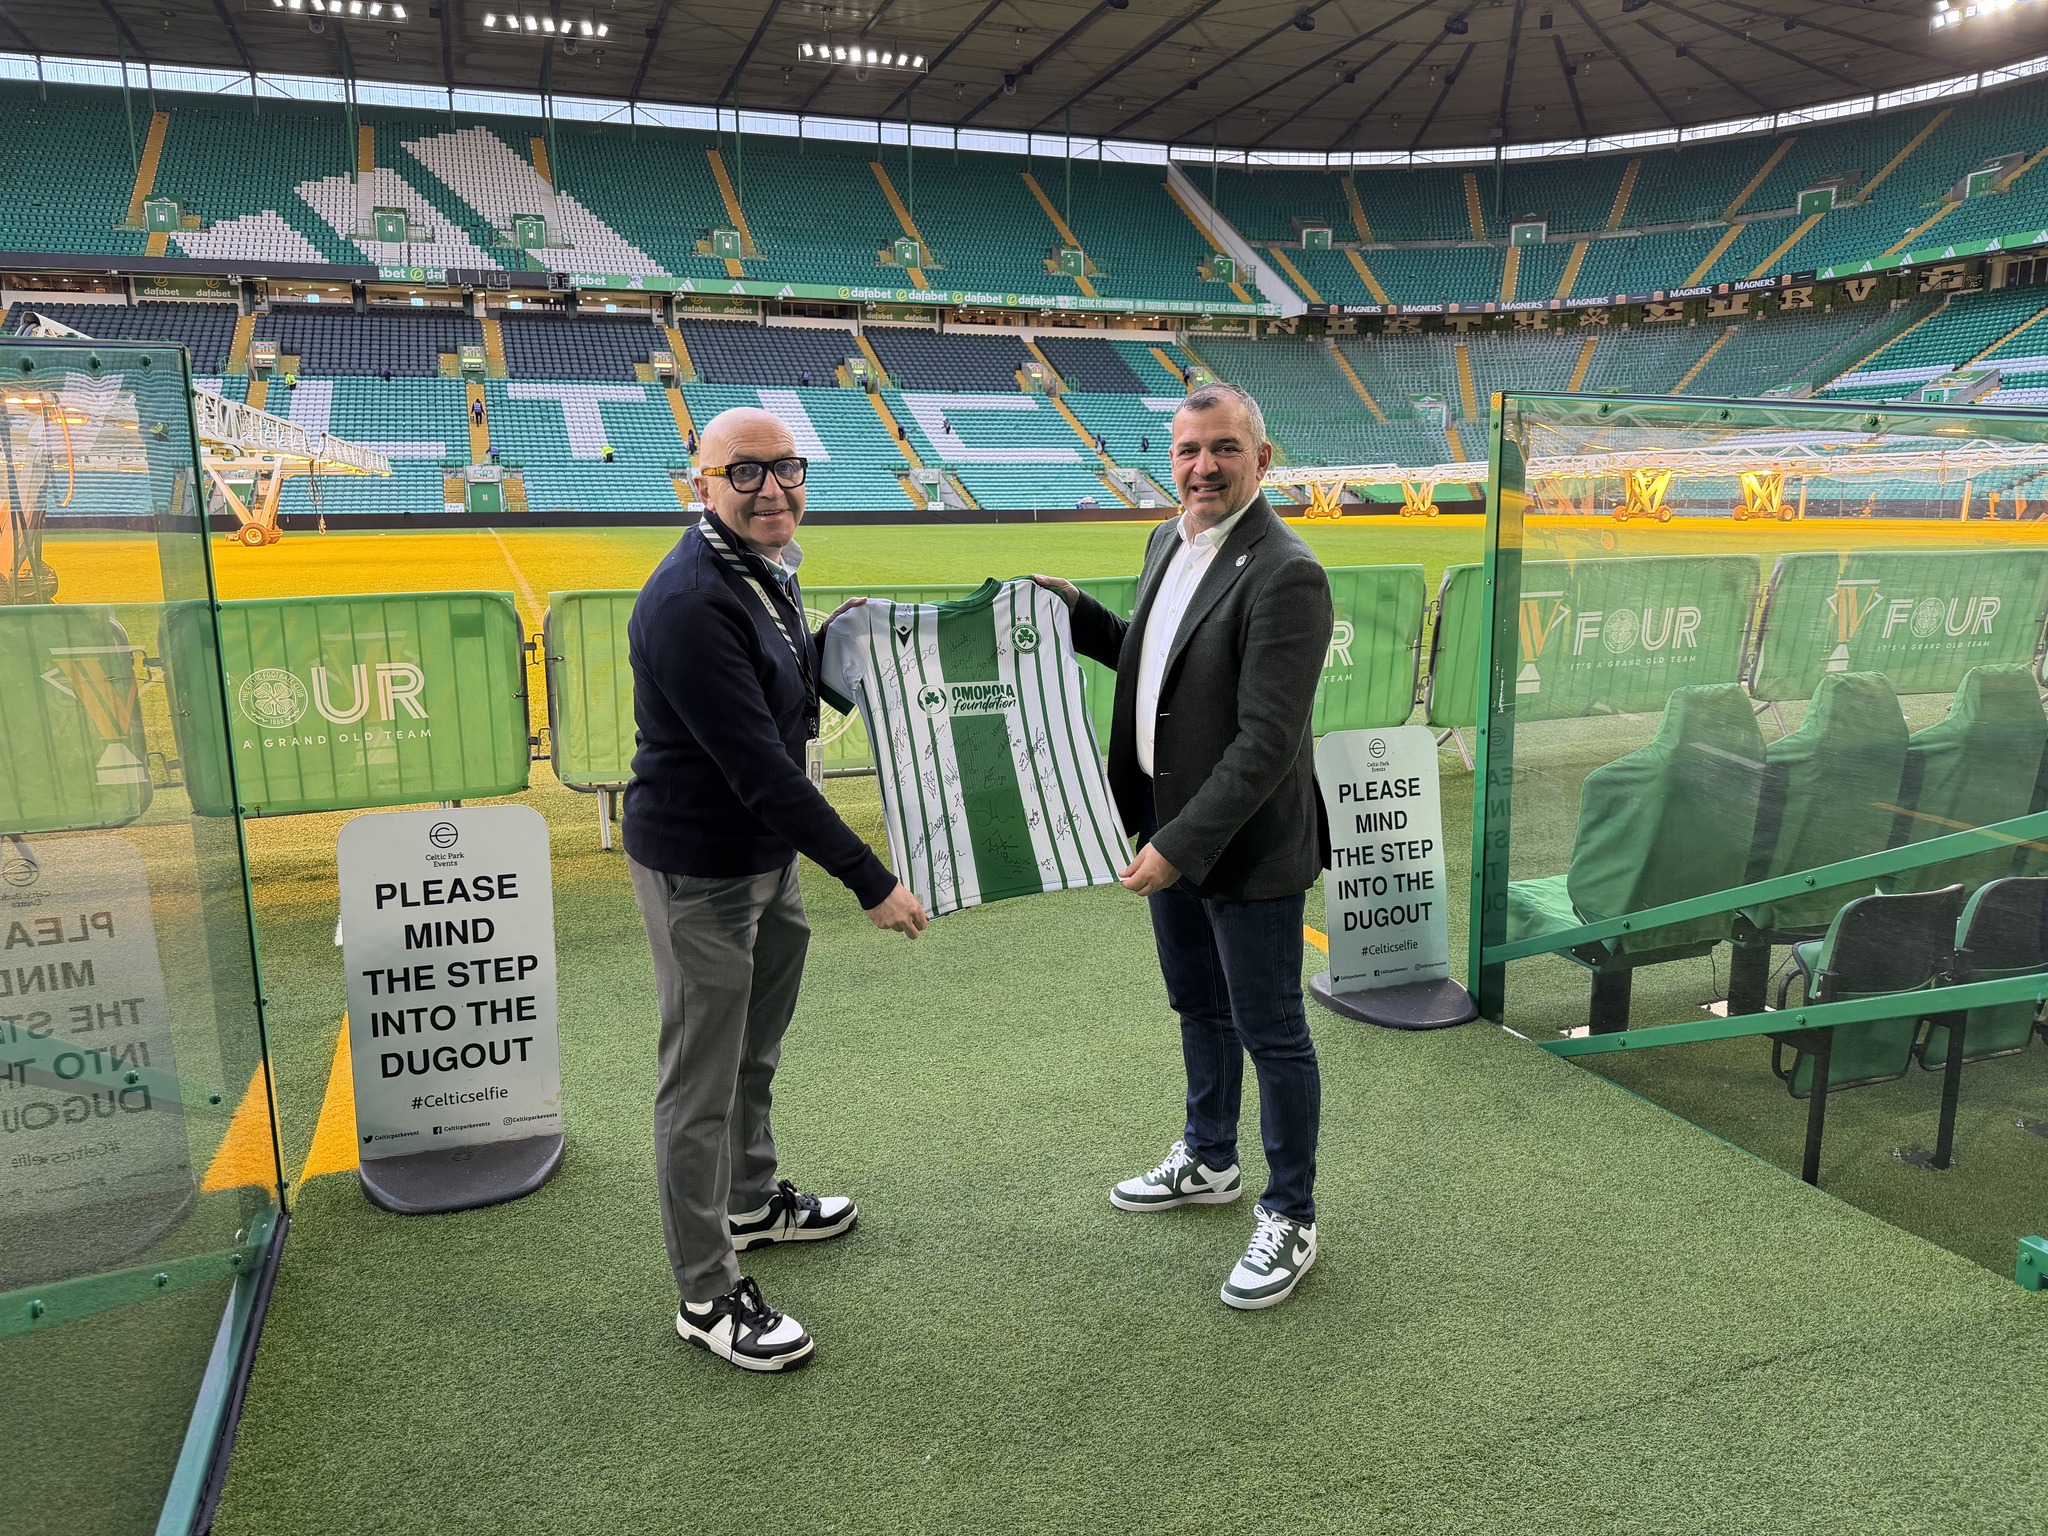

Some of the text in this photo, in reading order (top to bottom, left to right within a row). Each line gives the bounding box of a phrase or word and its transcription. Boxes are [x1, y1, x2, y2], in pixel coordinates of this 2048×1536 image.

[1734, 277, 1776, 291] MAGNERS
[143, 287, 180, 297] dafabet
[195, 288, 231, 298] dafabet
[850, 287, 892, 300] dafabet
[908, 289, 948, 302] dafabet
[964, 291, 1003, 304] dafabet
[1669, 286, 1713, 298] MAGNERS
[1017, 294, 1056, 307] dafabet
[1102, 299, 1134, 309] FOUNDATION
[1144, 301, 1194, 311] FOOTBALL FOR GOOD
[1501, 300, 1544, 311] MAGNERS
[1566, 296, 1609, 307] MAGNERS
[682, 304, 712, 314] dafabet
[723, 305, 753, 315] dafabet
[1227, 304, 1257, 313] FOUNDATION
[1343, 305, 1382, 314] MAGNERS
[1402, 304, 1443, 313] MAGNERS
[866, 312, 893, 321] dafabet
[904, 313, 931, 322] dafabet
[1877, 644, 1897, 652] IT'S
[1911, 643, 1941, 651] GRAND
[1946, 641, 1963, 649] OLD
[1967, 640, 1990, 648] TEAM
[1570, 662, 1592, 671] IT'S
[1607, 658, 1641, 668] GRAND
[1645, 656, 1665, 665] OLD
[1670, 655, 1697, 664] TEAM
[1323, 673, 1353, 683] TEAM
[951, 684, 1016, 701] OMONOIA
[953, 694, 1017, 715] foundation
[243, 728, 432, 749] A GRAND OLD TEAM
[1338, 777, 1421, 804] PLEASE
[1355, 810, 1408, 834] MIND
[425, 852, 465, 862] Celtic Park
[1332, 839, 1434, 868] THE STEP
[433, 860, 458, 868] Events
[1338, 870, 1435, 900] INTO THE
[375, 873, 519, 910] PLEASE
[1343, 901, 1433, 932] DUGOUT
[404, 917, 495, 950] MIND
[1361, 939, 1419, 956] #Celticselfie
[362, 954, 539, 996] THE STEP
[371, 995, 537, 1038] INTO THE
[380, 1036, 534, 1079] DUGOUT
[411, 1086, 509, 1110] #Celticselfie
[512, 1112, 558, 1123] Celticparkevents
[443, 1121, 491, 1132] Celticparkevents
[374, 1130, 420, 1141] Celticparkevent
